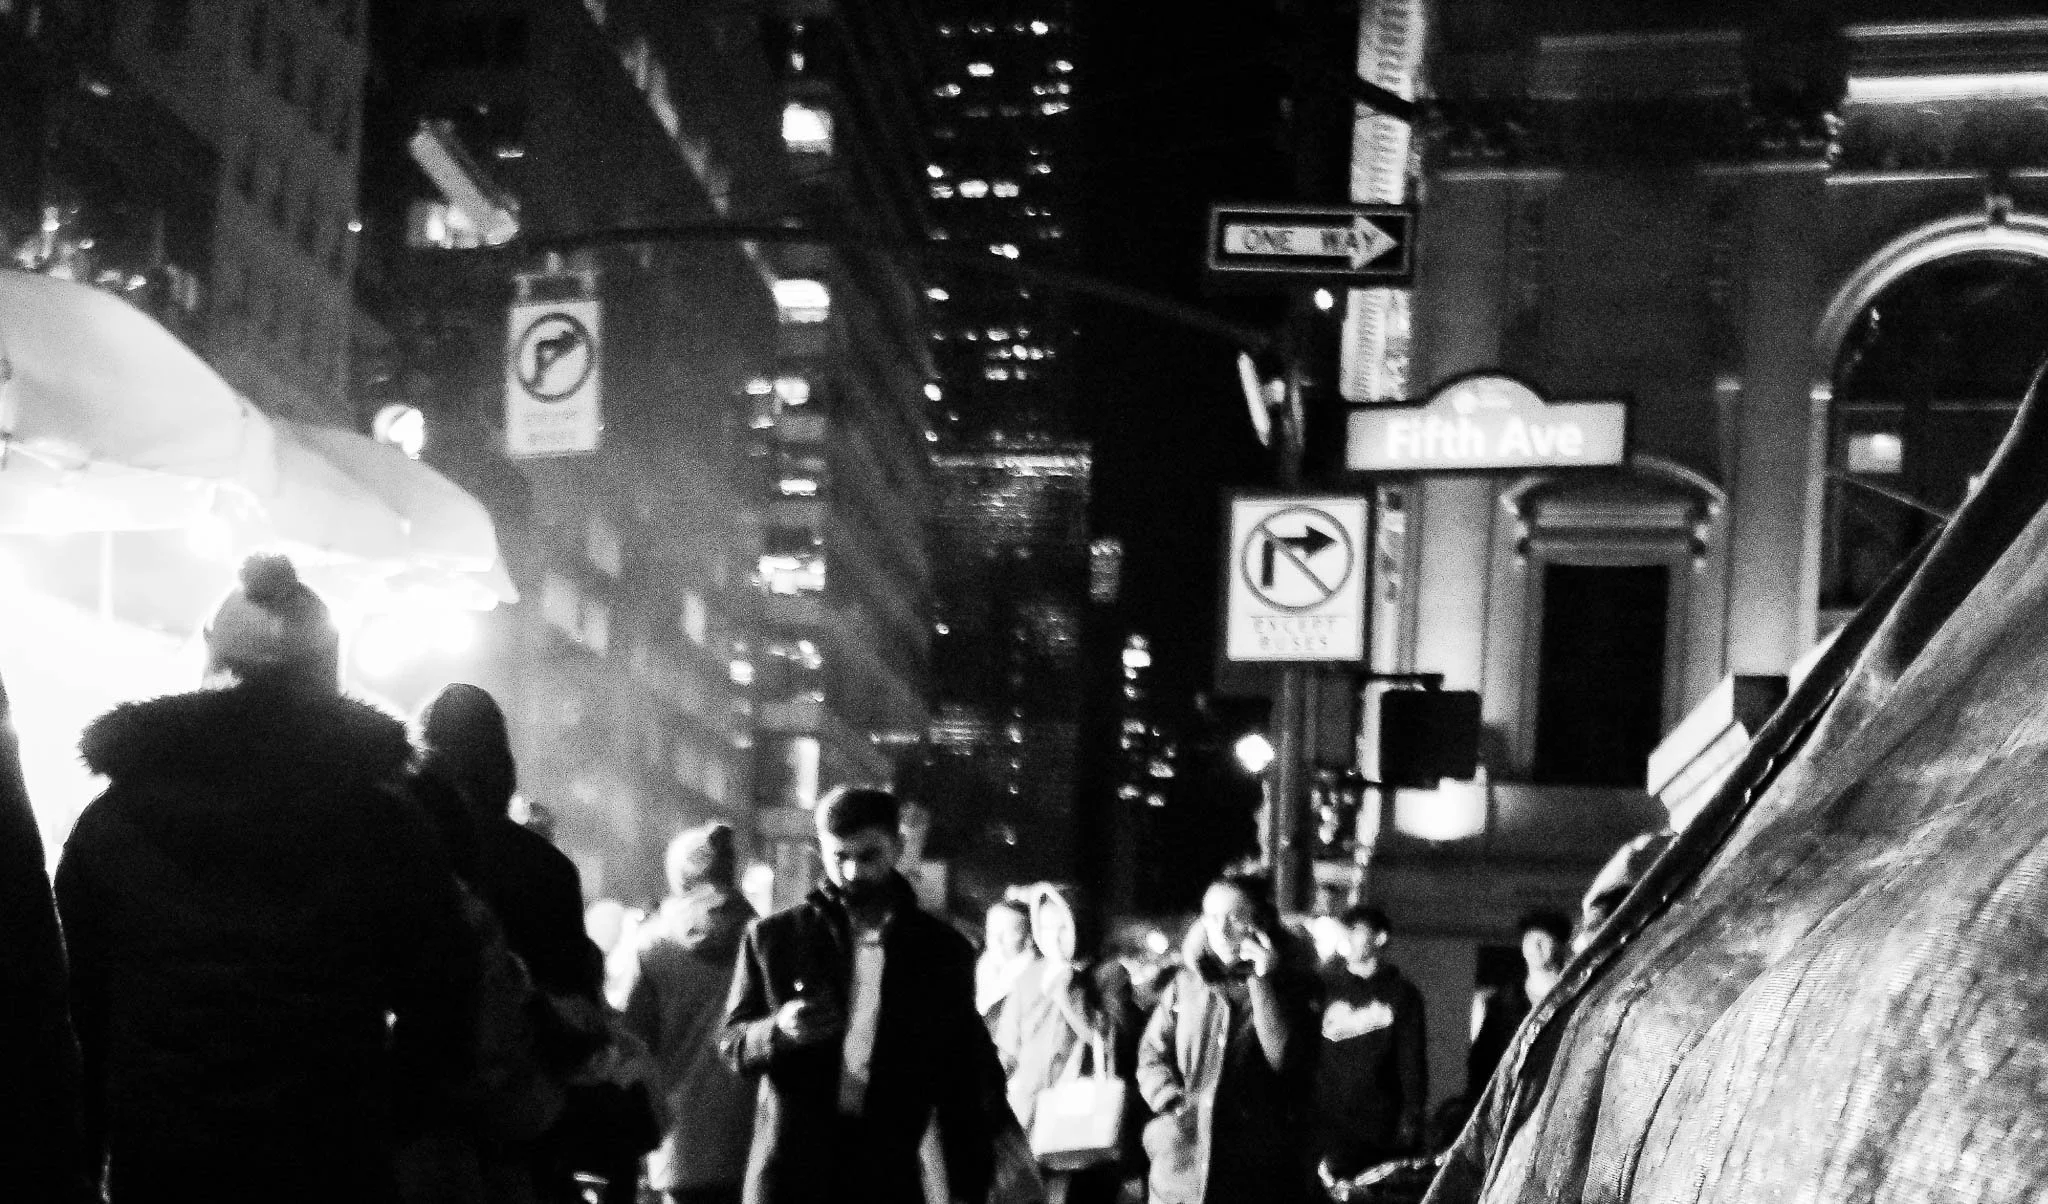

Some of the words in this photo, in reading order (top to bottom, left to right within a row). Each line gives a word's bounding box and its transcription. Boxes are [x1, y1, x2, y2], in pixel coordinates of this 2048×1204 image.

[1242, 228, 1293, 252] ONE
[1320, 229, 1379, 254] WAY
[1385, 412, 1486, 460] Fifth
[1497, 415, 1583, 458] Ave
